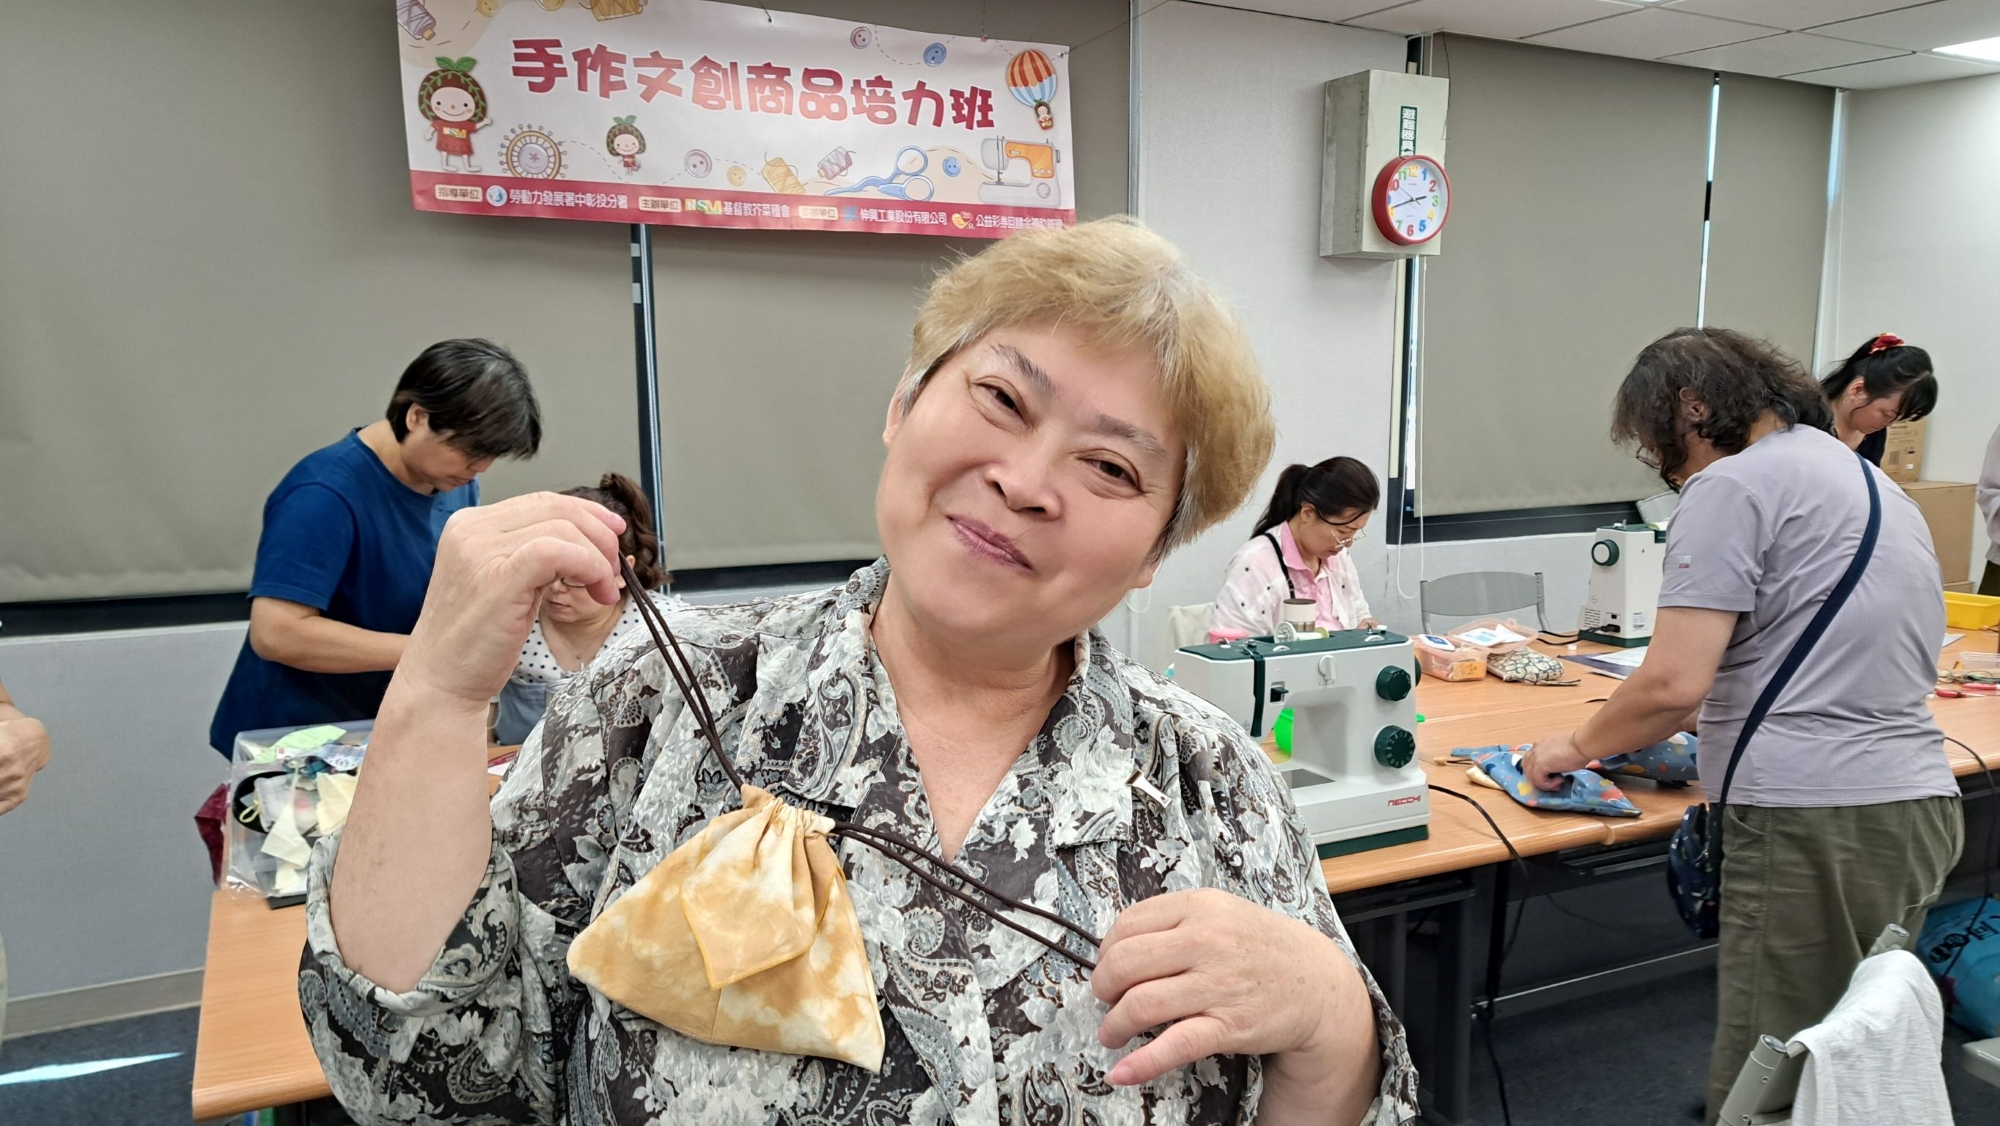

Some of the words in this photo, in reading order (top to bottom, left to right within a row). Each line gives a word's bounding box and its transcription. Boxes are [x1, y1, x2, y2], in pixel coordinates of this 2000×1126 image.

[511, 38, 996, 131] 手作文創商品培力班
[1398, 168, 1407, 181] 11
[1408, 164, 1419, 177] 12
[1422, 168, 1428, 181] 1
[1429, 180, 1437, 192] 2
[437, 187, 480, 200] 指導單位
[509, 187, 629, 210] 勞動力發展署中彰投分署
[1432, 194, 1439, 207] 3
[684, 198, 723, 215] NSM
[723, 200, 791, 218] 基督教芥菜種會
[1427, 208, 1435, 221] 4
[860, 207, 948, 226] 伸興工業股份有限公司
[1396, 219, 1403, 231] 7
[1407, 224, 1414, 237] 6
[1419, 219, 1427, 232] 5
[1387, 795, 1422, 807] NECCHI
